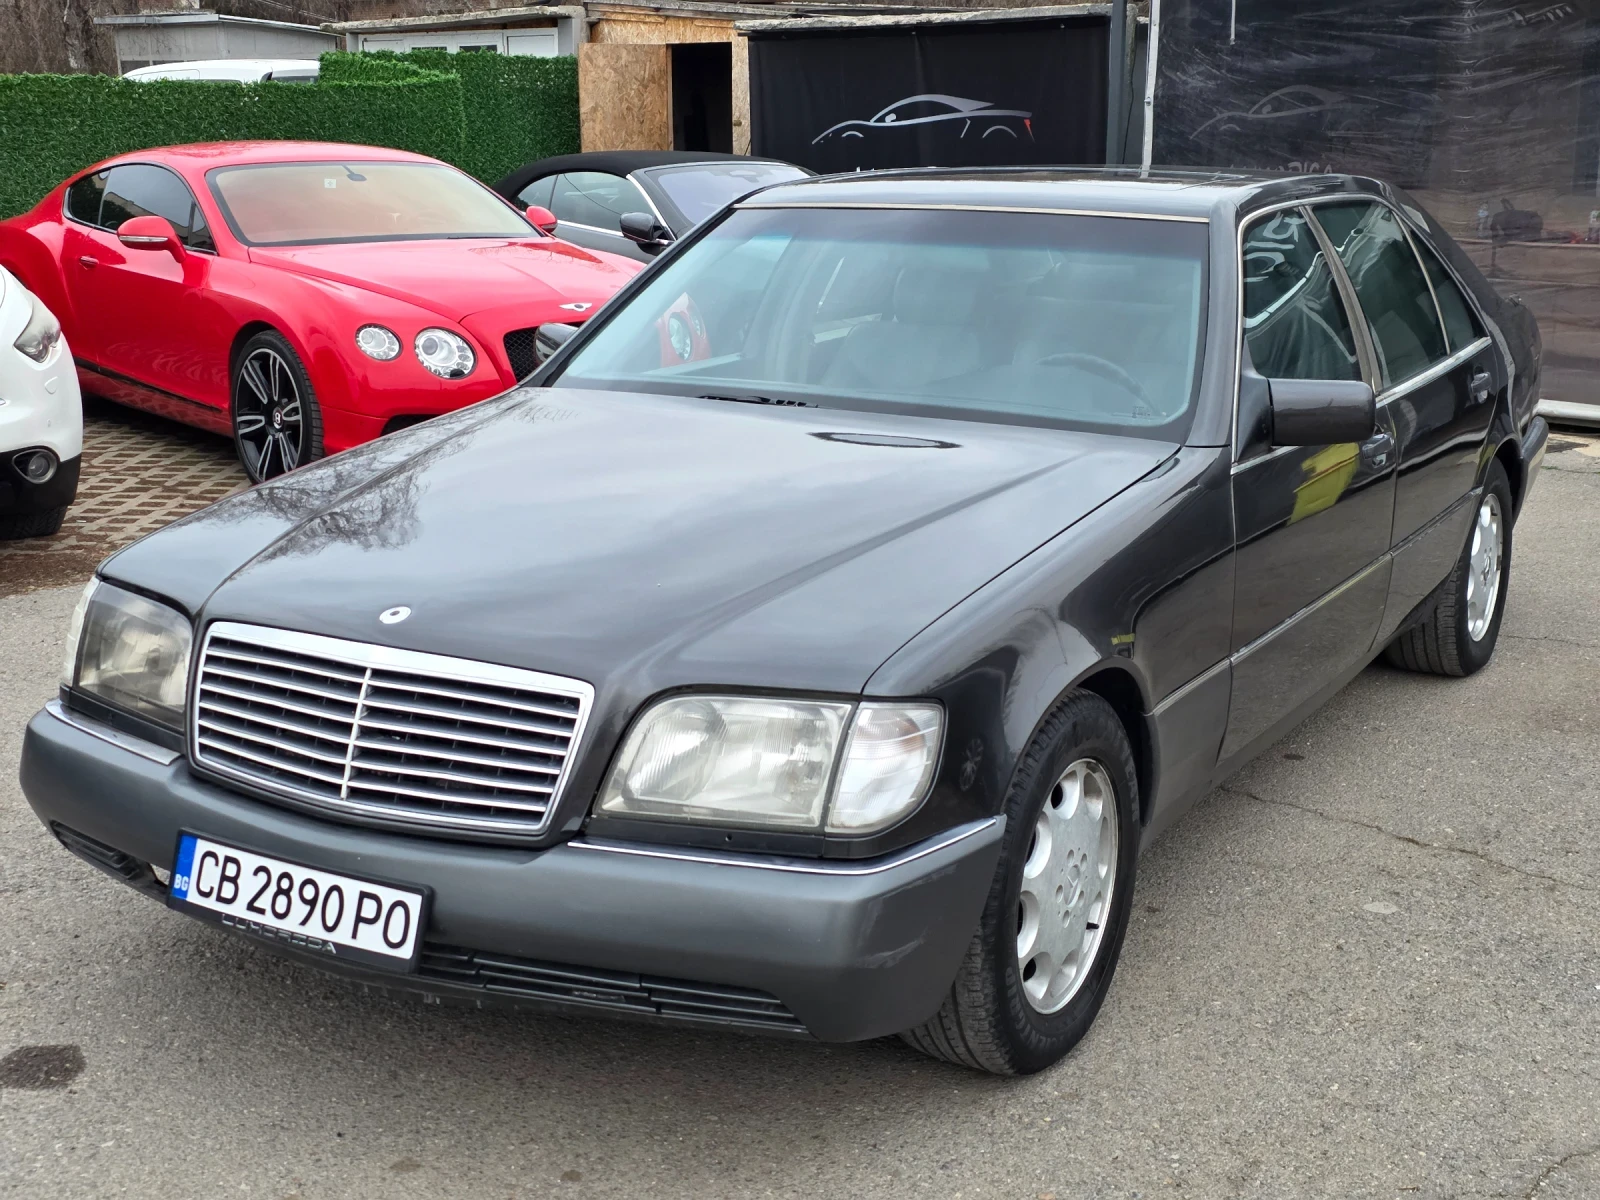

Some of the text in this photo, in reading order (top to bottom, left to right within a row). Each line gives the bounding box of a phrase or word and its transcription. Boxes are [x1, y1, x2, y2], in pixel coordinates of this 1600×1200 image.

[173, 873, 190, 892] BG
[195, 850, 242, 905] CB
[246, 865, 345, 933] 2890
[351, 890, 411, 949] PO
